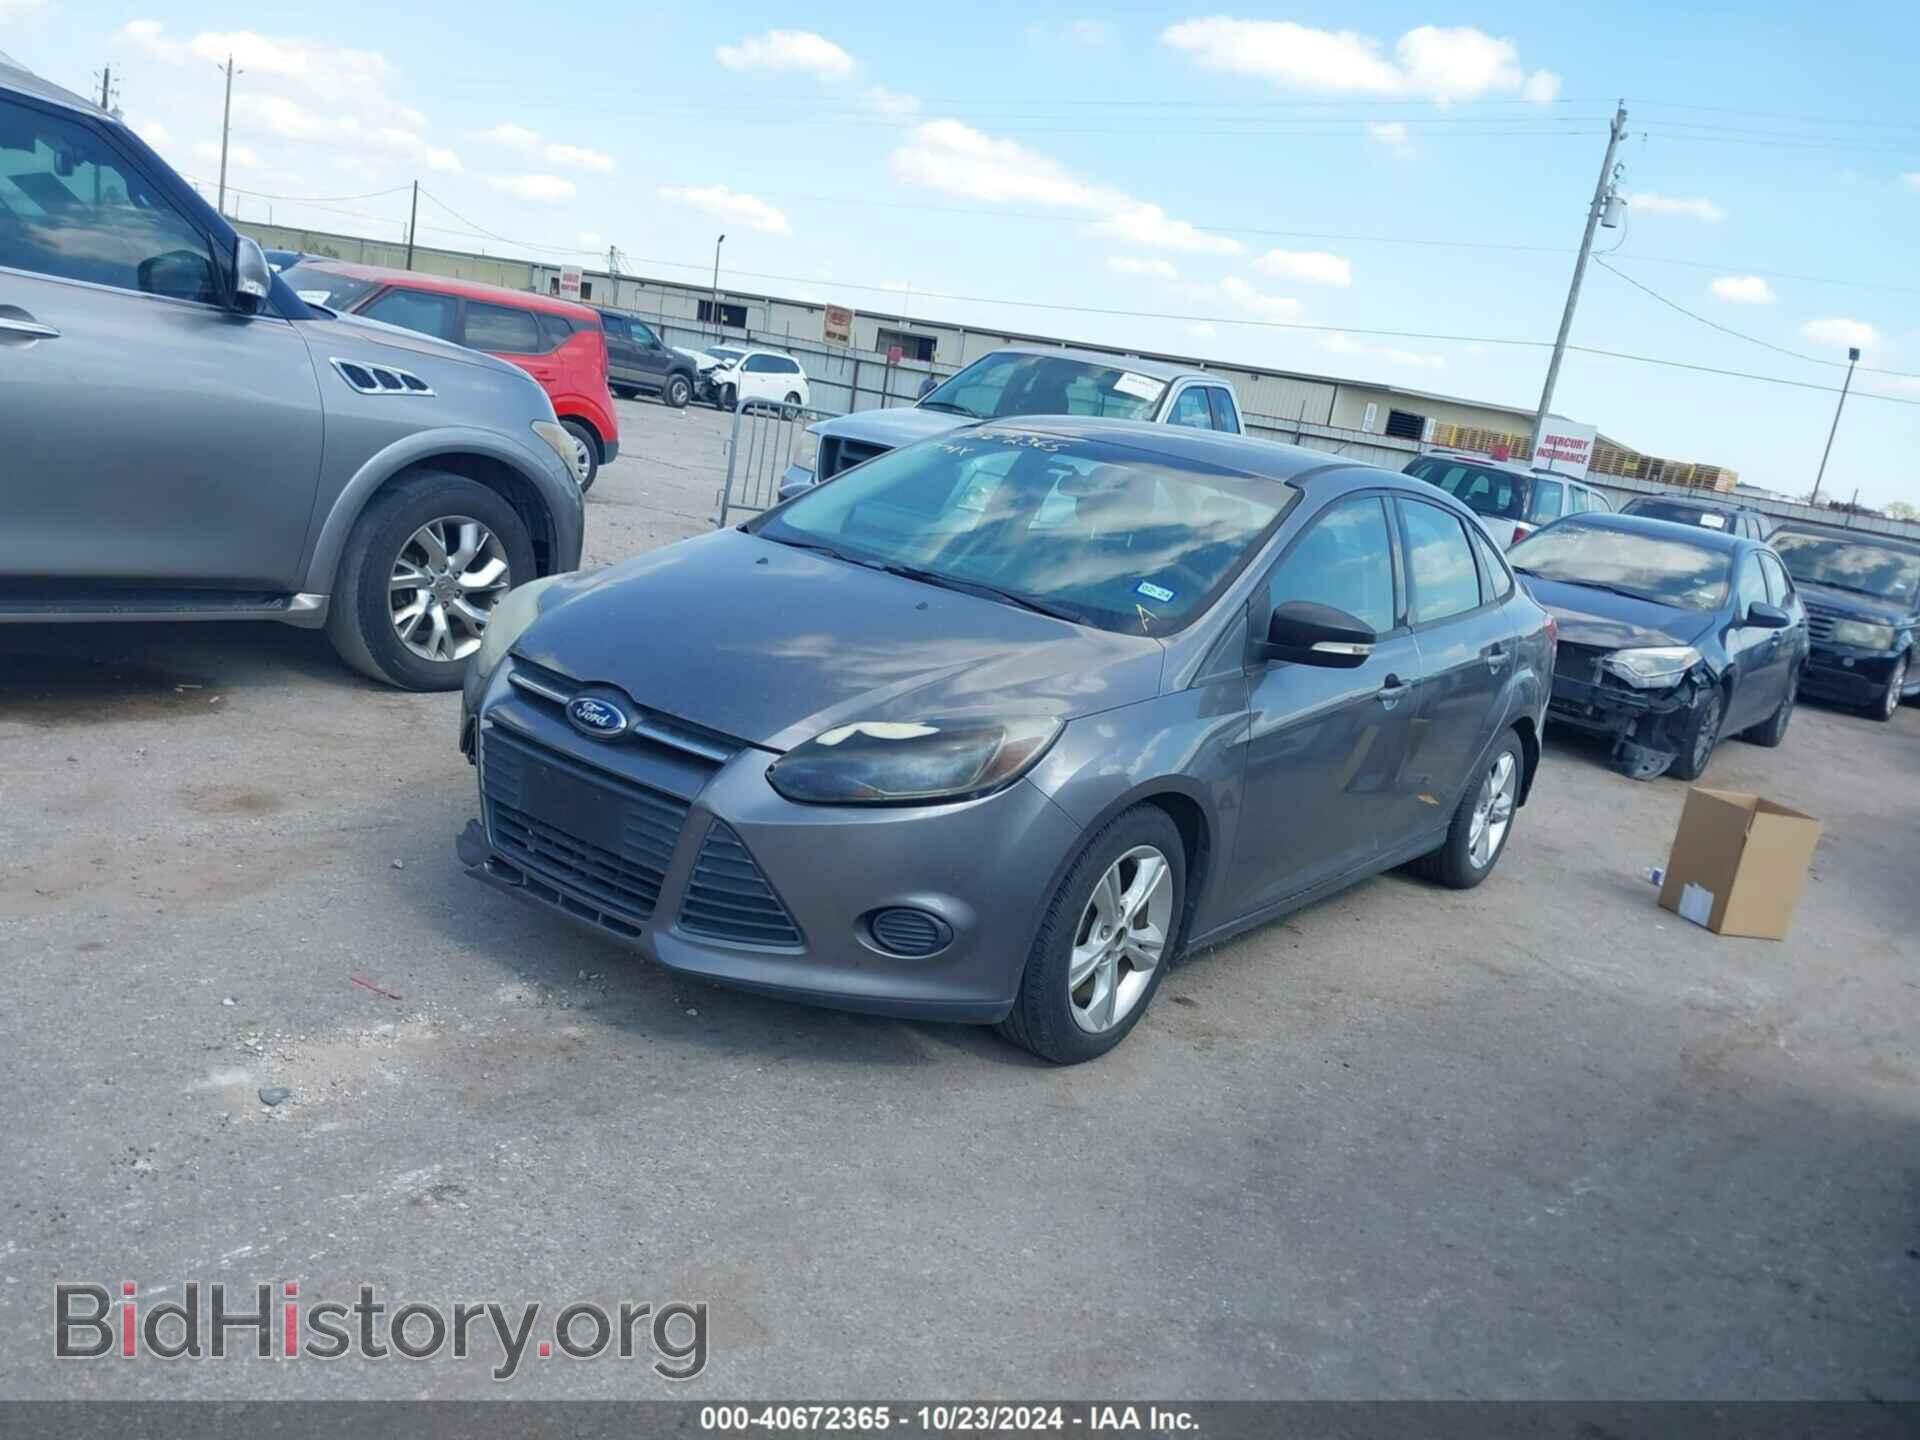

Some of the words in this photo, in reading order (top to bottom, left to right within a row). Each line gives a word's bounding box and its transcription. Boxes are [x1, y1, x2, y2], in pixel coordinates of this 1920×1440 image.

[1545, 435, 1590, 449] MERCURY
[1537, 448, 1588, 464] INSURANCE
[576, 702, 611, 726] Ford
